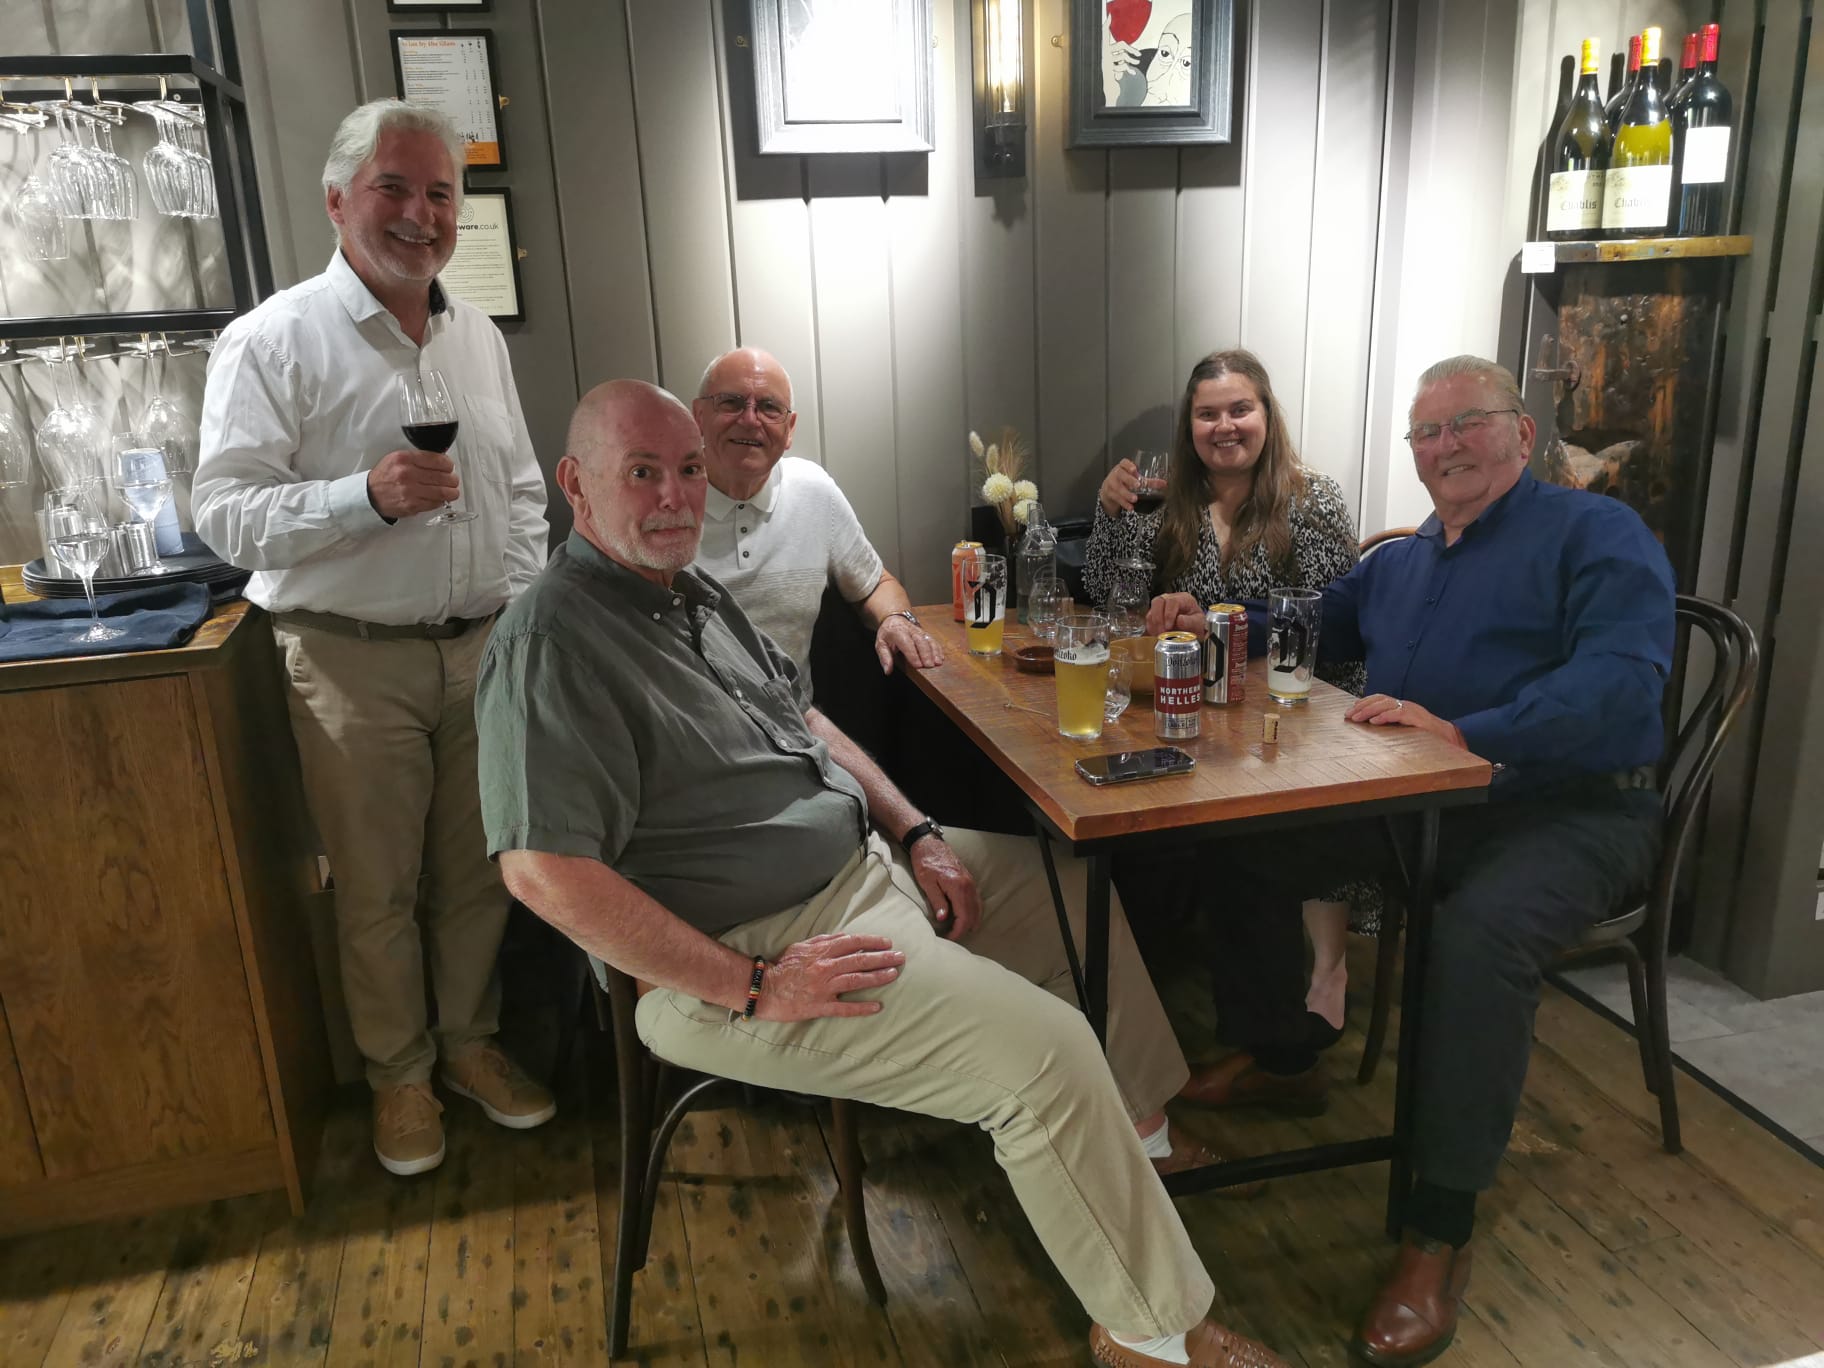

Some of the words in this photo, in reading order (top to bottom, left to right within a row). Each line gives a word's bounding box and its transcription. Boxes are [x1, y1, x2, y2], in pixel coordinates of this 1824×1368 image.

[457, 223, 499, 231] ware.co.uk
[1160, 685, 1200, 695] NORTHERN
[1160, 693, 1200, 705] HELLES
